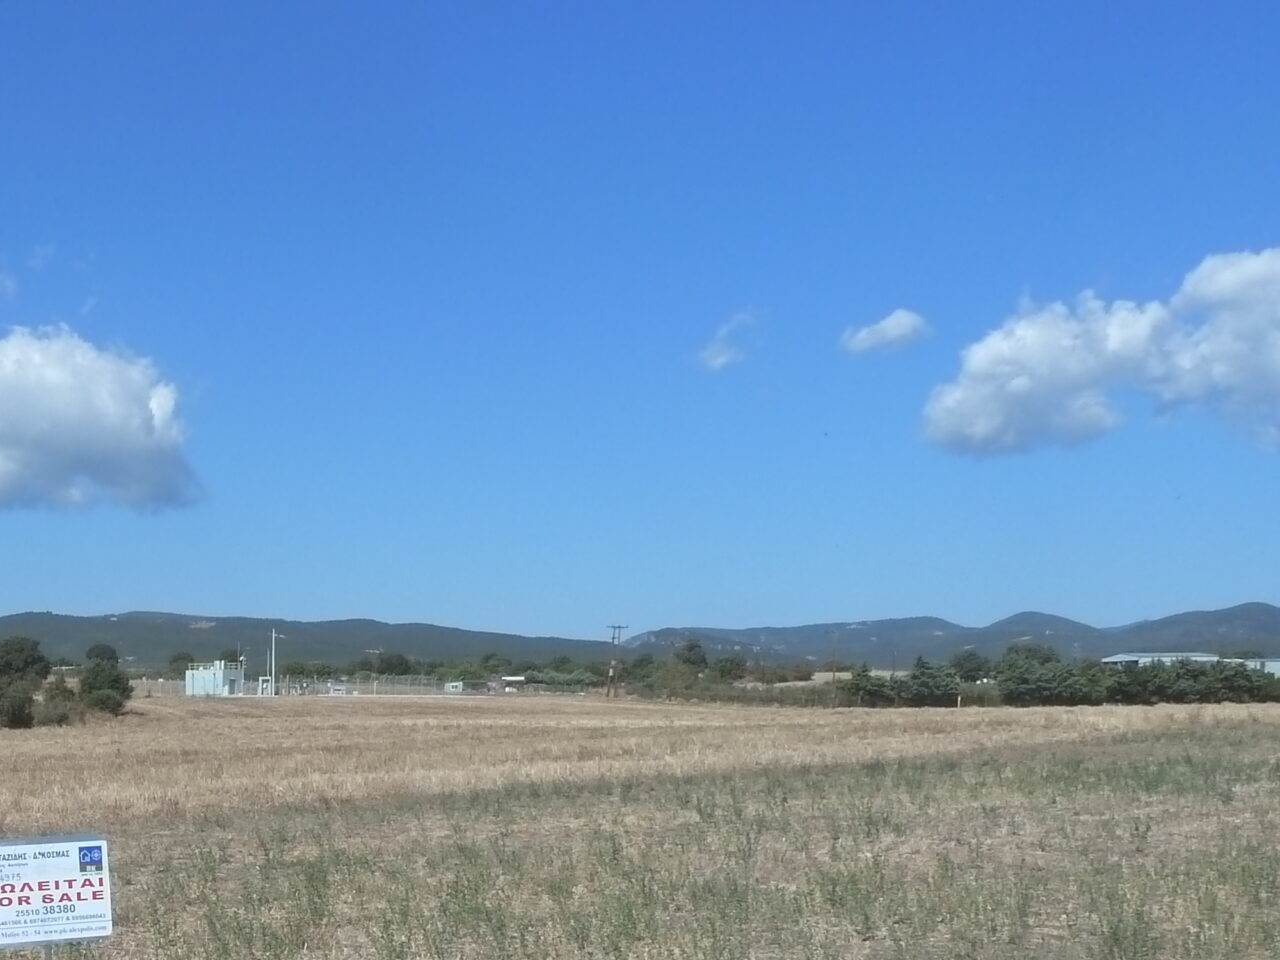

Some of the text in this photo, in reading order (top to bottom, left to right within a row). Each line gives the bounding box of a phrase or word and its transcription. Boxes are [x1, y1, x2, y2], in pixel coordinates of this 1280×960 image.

[42, 890, 105, 904] SALE
[15, 904, 76, 917] 25510 38380
